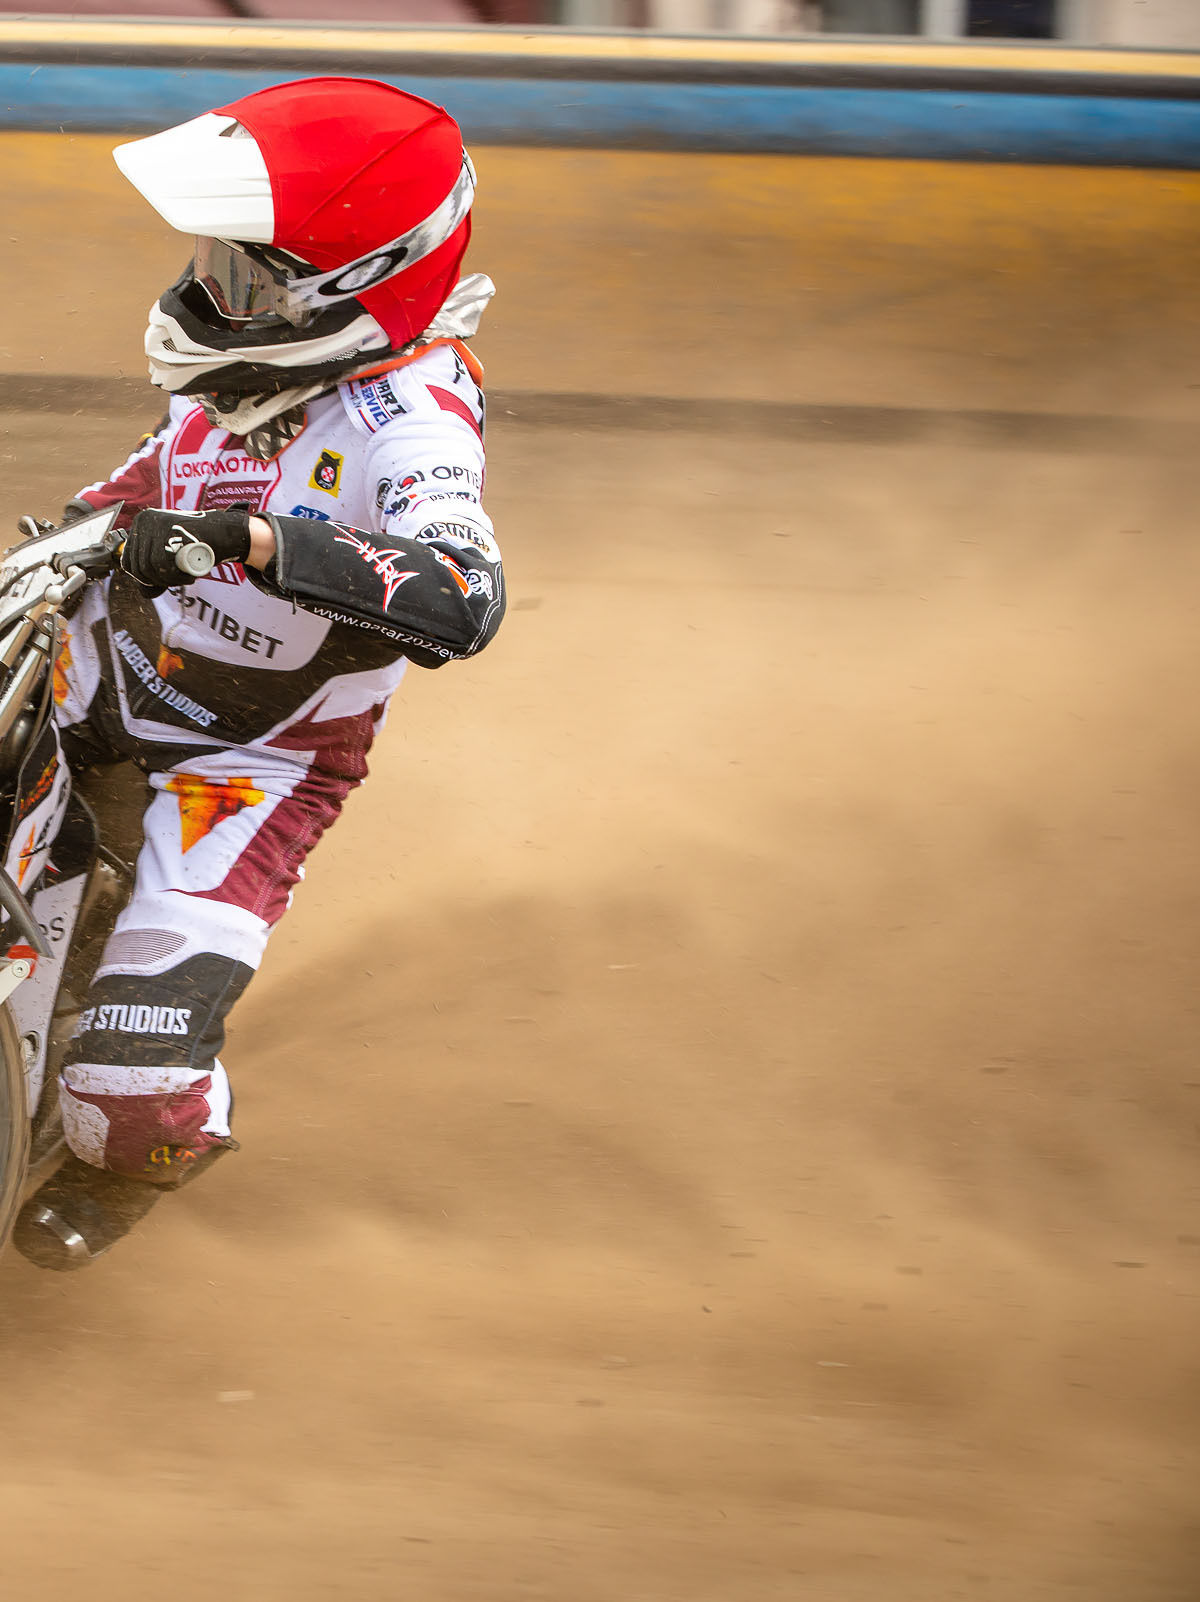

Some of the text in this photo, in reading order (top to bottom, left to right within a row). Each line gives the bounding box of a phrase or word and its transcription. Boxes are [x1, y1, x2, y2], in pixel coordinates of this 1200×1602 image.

[174, 456, 271, 478] LOKOMOTIV
[168, 587, 284, 660] PTIBET
[113, 630, 219, 727] AMBER STUDIOS
[94, 1004, 192, 1036] STUDIOS
